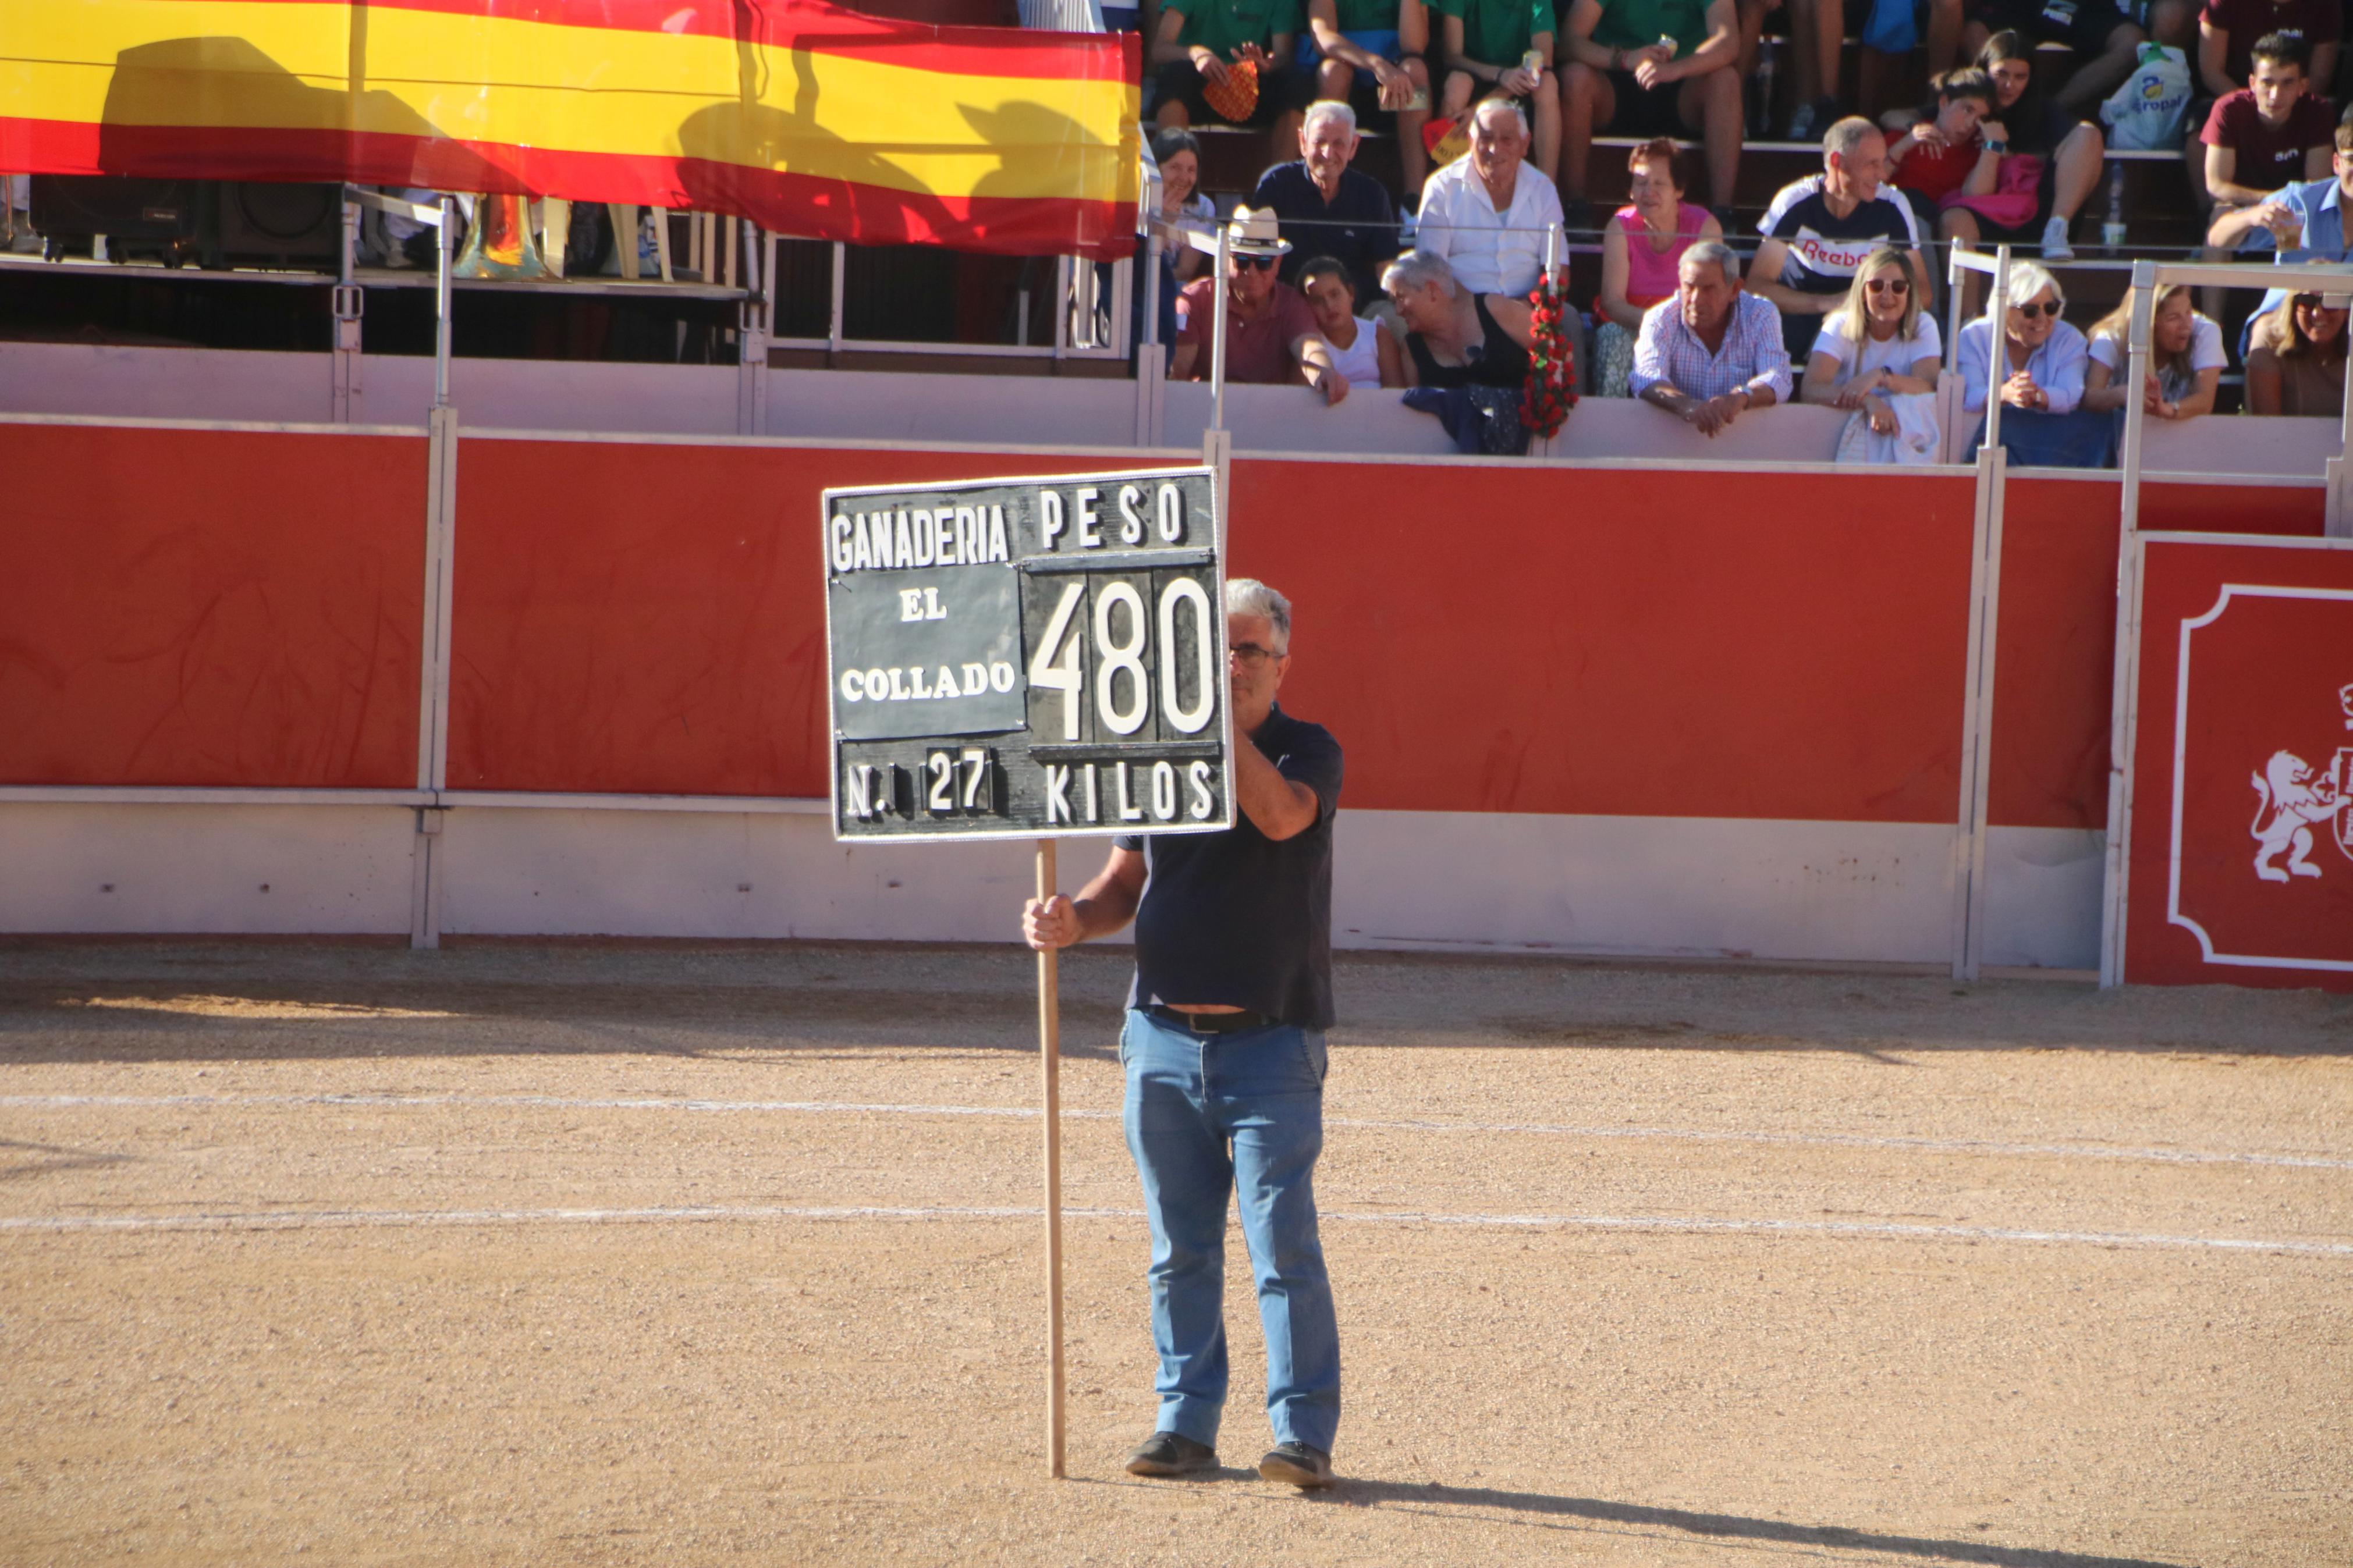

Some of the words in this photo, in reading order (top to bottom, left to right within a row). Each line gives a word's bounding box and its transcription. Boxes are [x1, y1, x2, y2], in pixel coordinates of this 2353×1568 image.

[831, 504, 1009, 572] GANADERIA
[1041, 484, 1181, 549] PESO
[900, 587, 947, 622] EL
[840, 662, 1015, 702] COLLADO
[1030, 577, 1215, 742] 480
[929, 751, 985, 811] 27
[1047, 760, 1213, 824] KILOS
